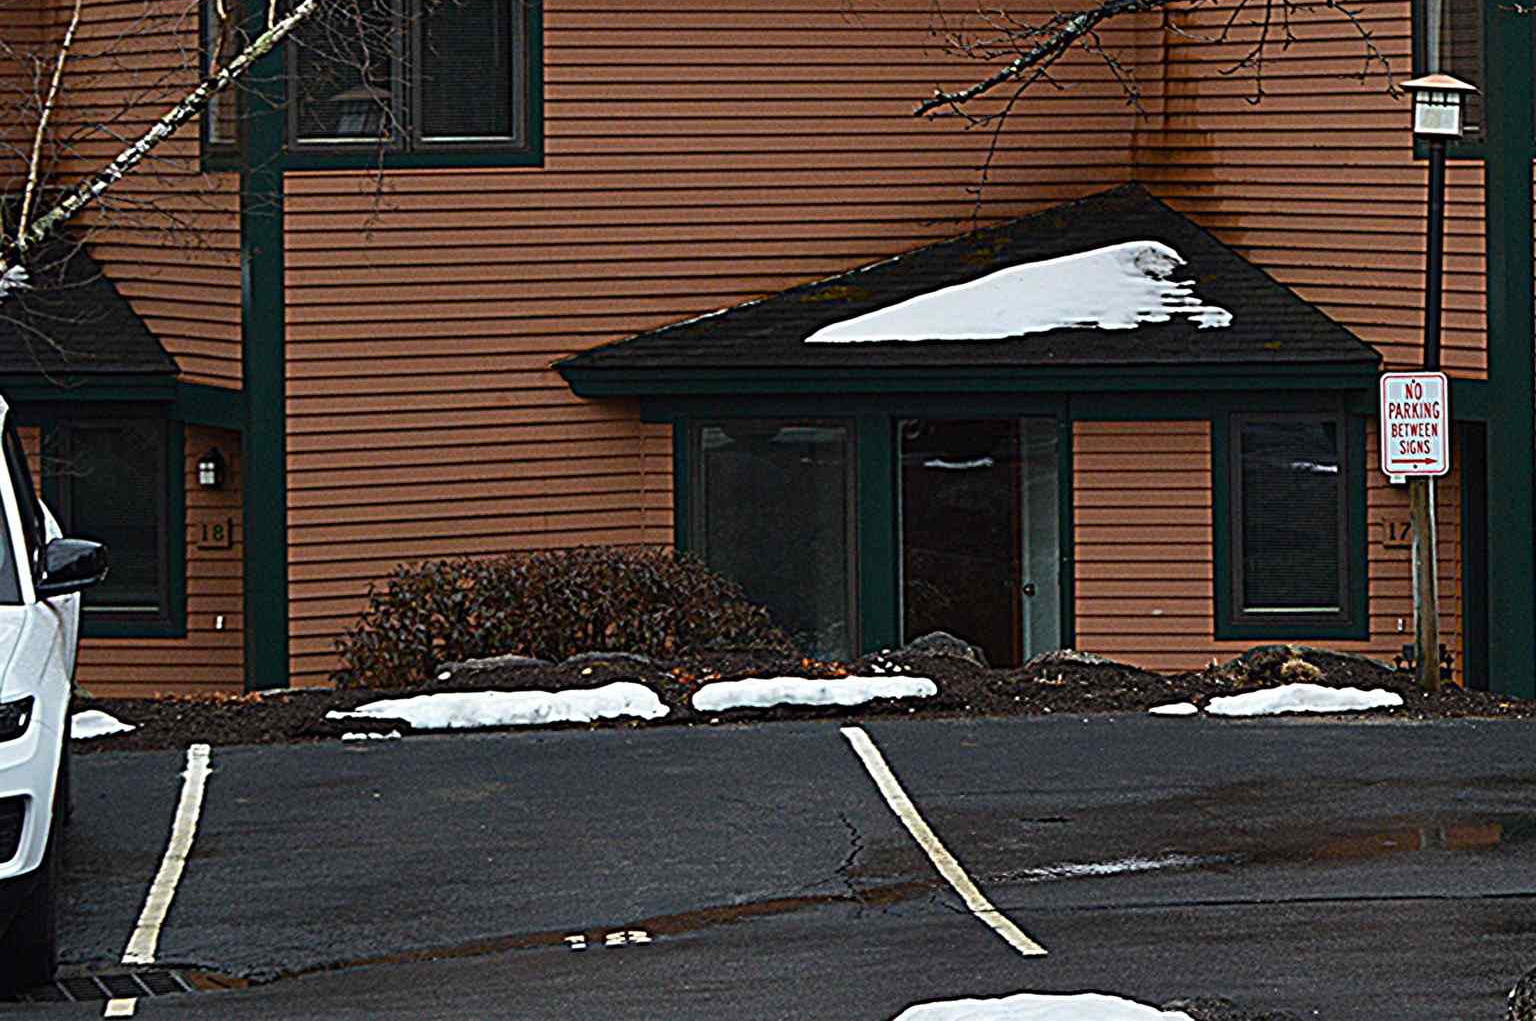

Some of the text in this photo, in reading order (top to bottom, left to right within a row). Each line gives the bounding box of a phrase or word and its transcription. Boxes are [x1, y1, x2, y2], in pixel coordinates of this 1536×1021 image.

[1405, 383, 1423, 400] NO
[1389, 401, 1440, 419] PARKING
[1391, 423, 1438, 438] BETWEEN
[1399, 440, 1431, 454] SIGNS
[202, 524, 224, 541] 18
[1390, 522, 1411, 540] 17
